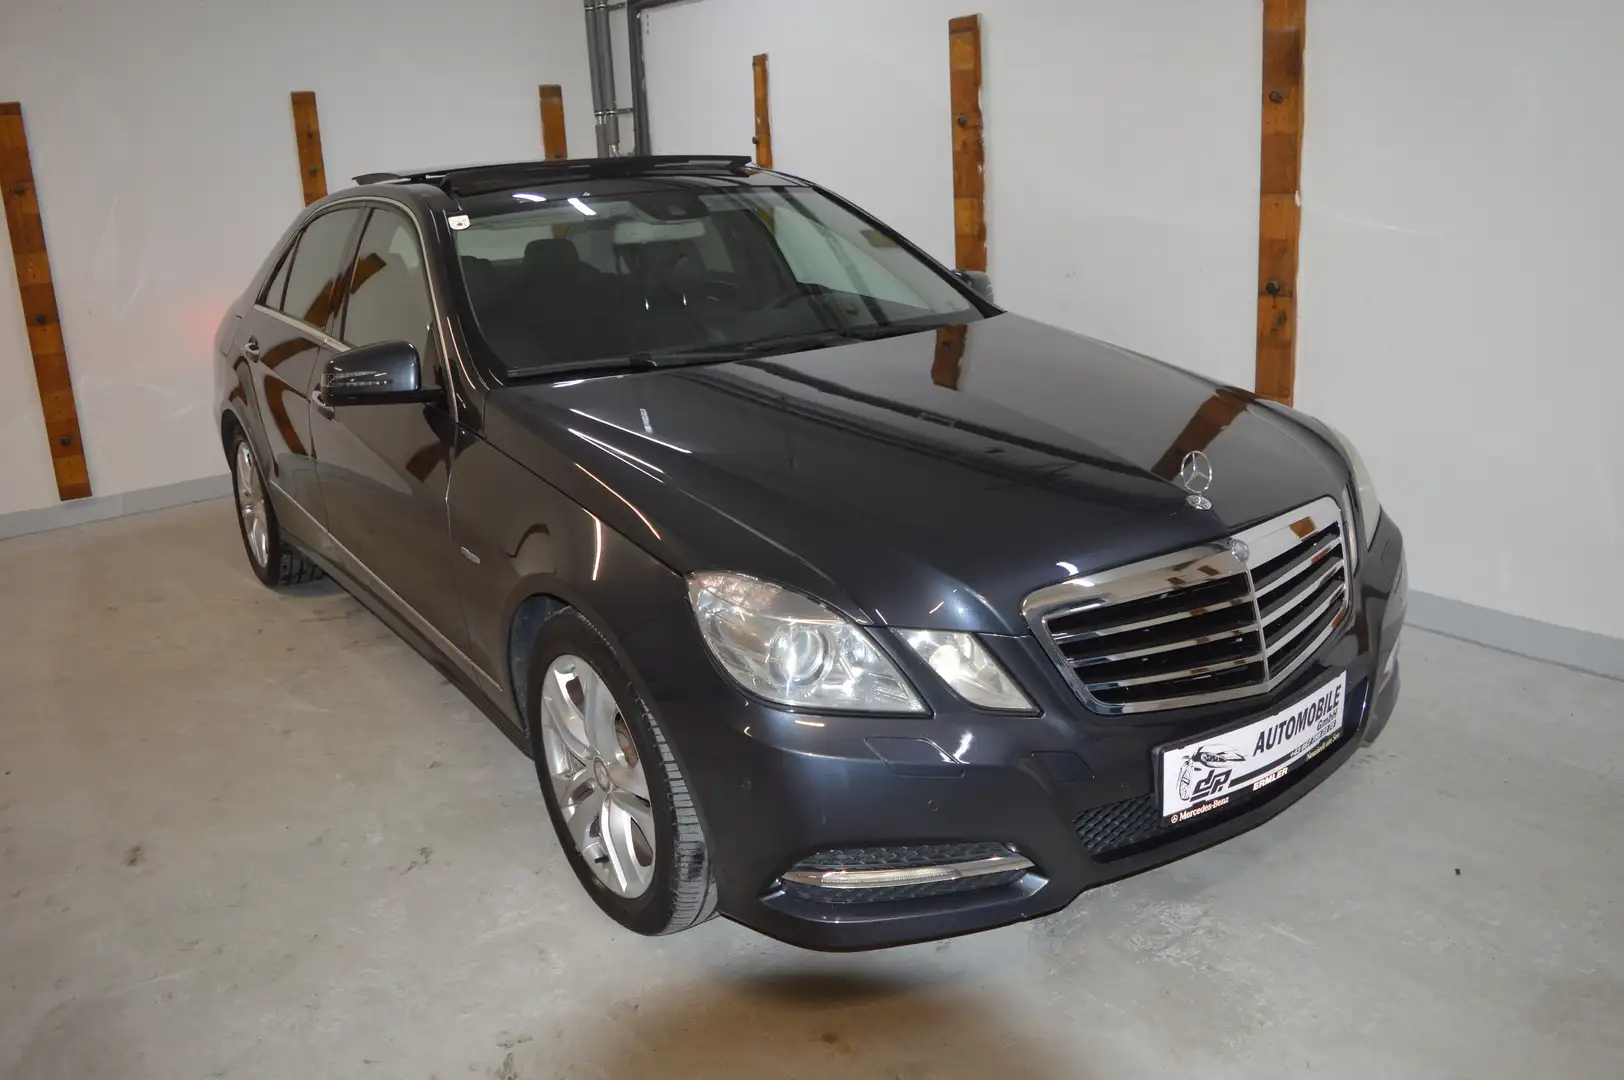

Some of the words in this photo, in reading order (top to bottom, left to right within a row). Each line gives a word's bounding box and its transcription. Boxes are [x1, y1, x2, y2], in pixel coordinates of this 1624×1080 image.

[1252, 685, 1341, 757] AUTOMOBILE
[1179, 796, 1230, 822] Mercedes-Benz
[1253, 767, 1288, 791] ERMLER
